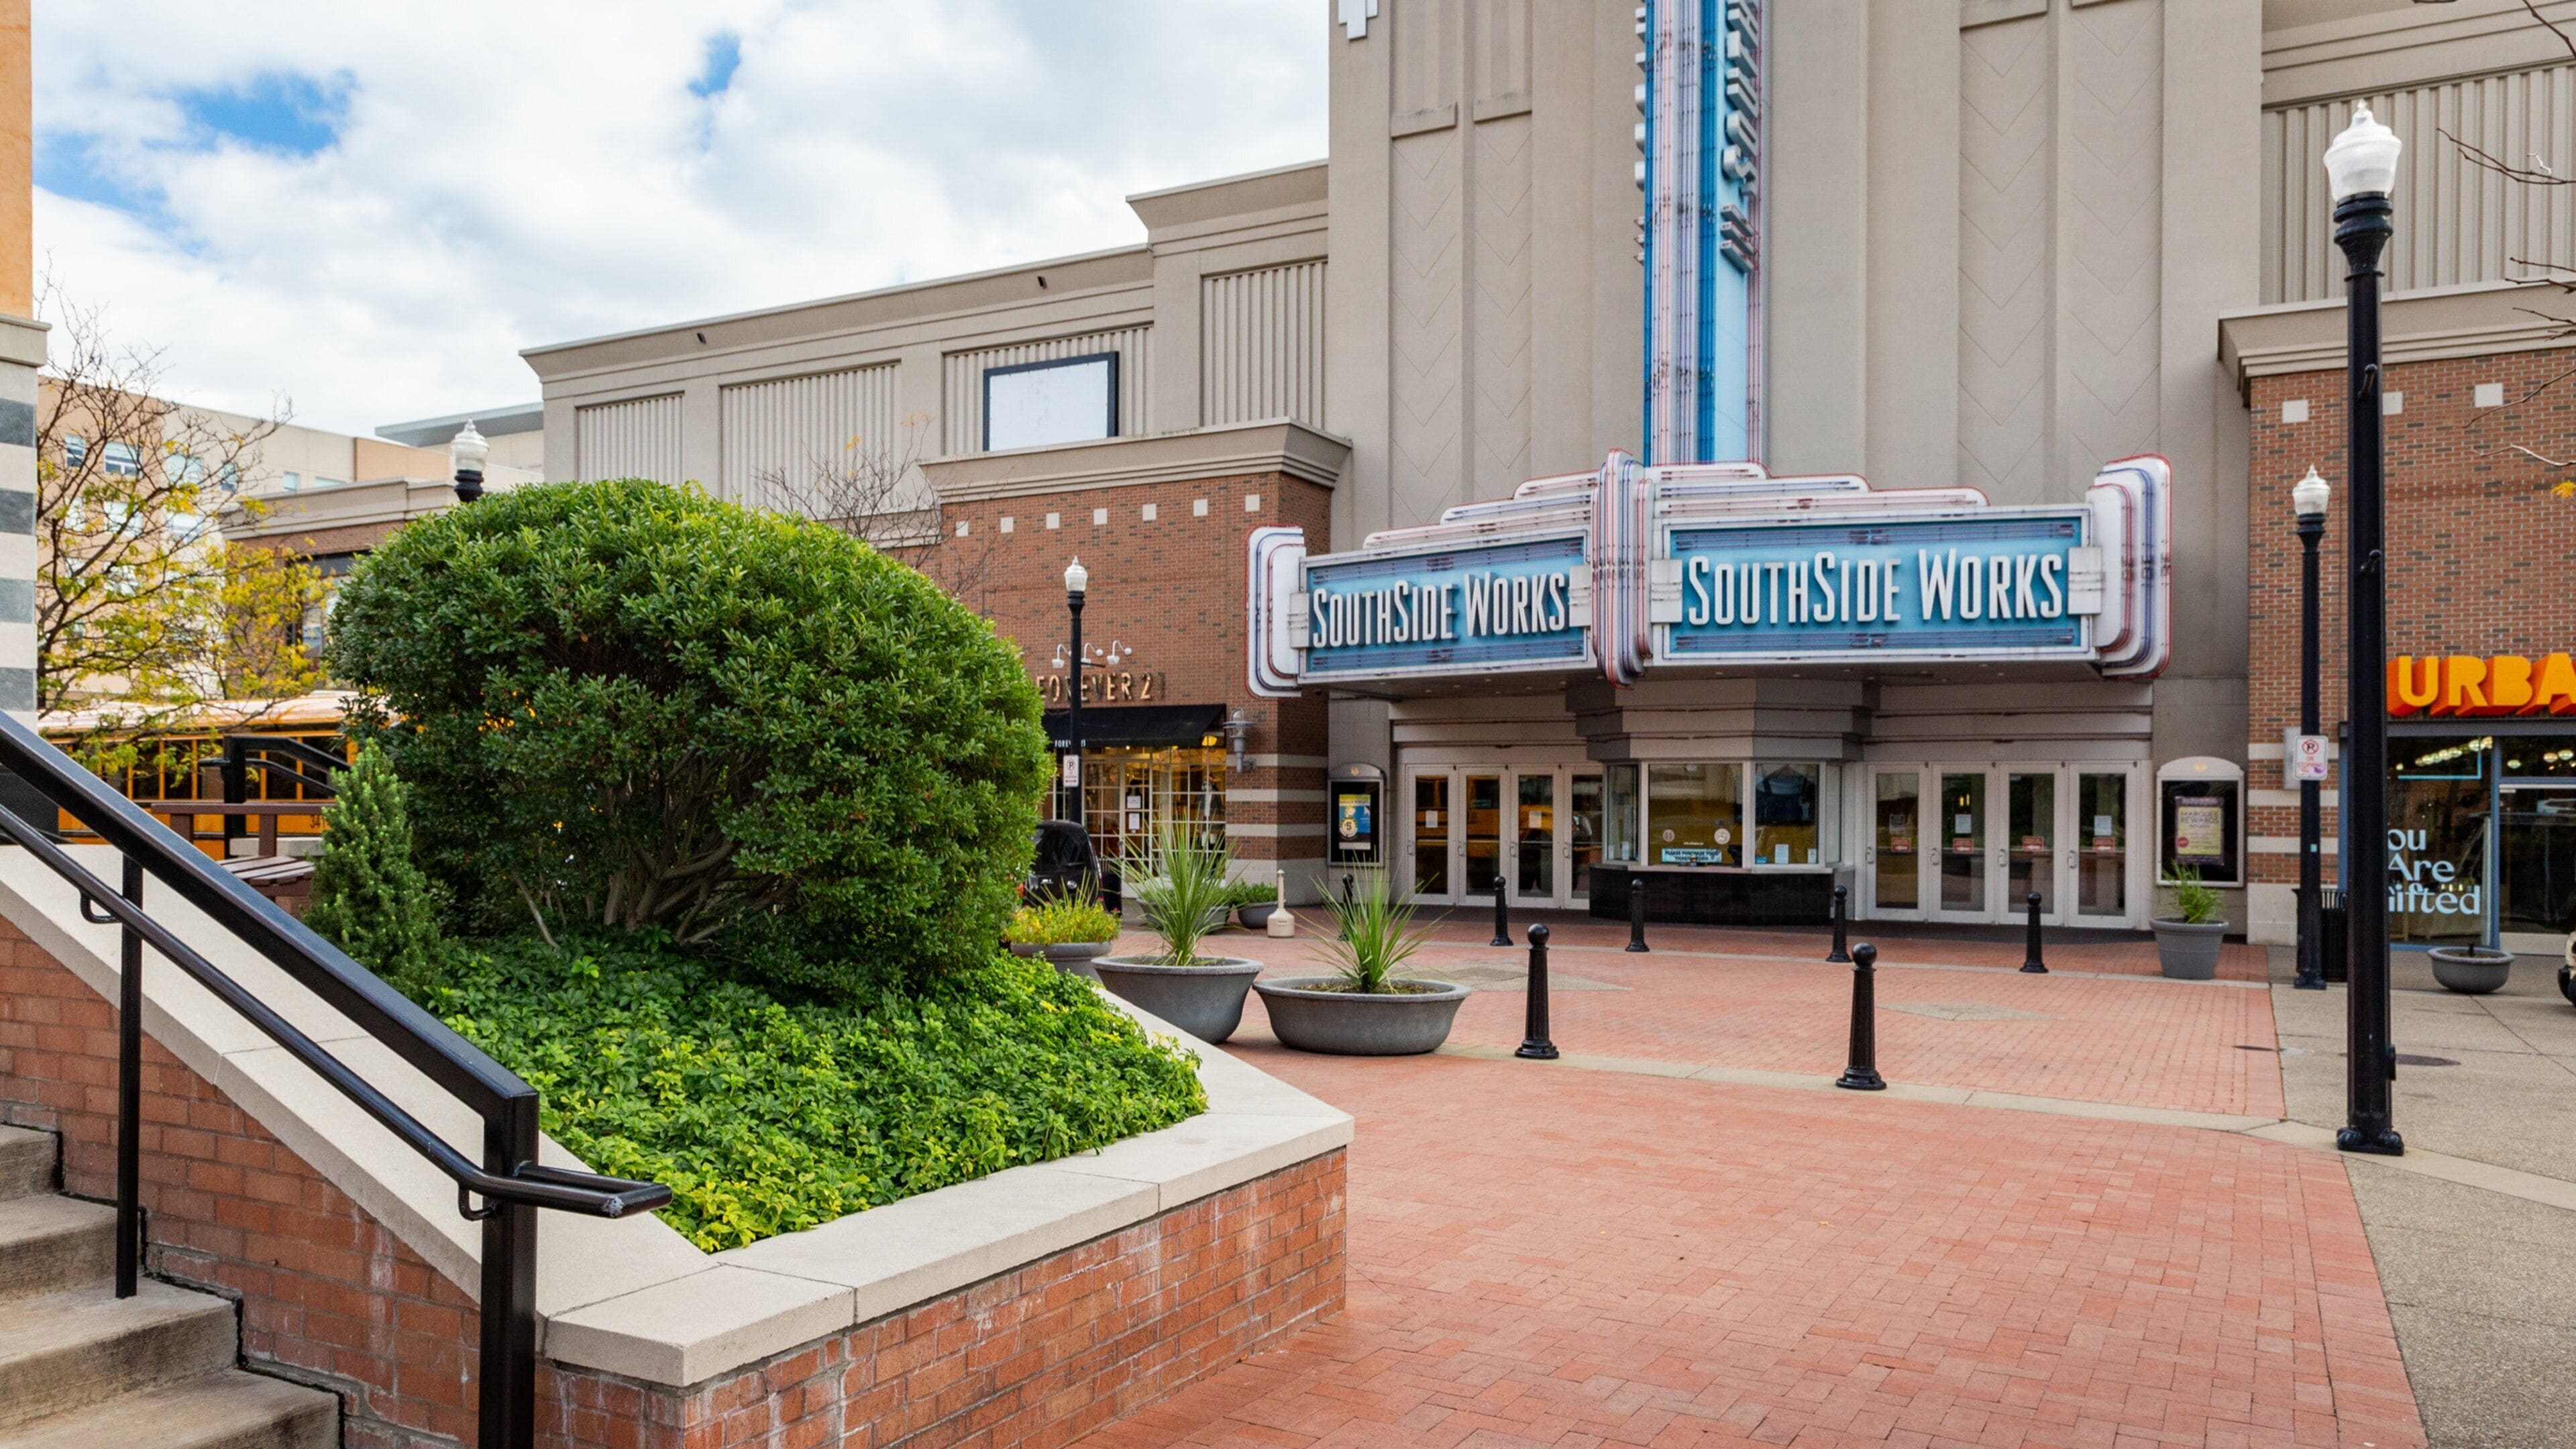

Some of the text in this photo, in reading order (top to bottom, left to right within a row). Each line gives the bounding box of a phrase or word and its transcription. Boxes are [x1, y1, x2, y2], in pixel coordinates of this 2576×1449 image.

[2388, 828, 2426, 851] ou
[2388, 853, 2454, 883] Are
[2388, 883, 2480, 915] ifted
